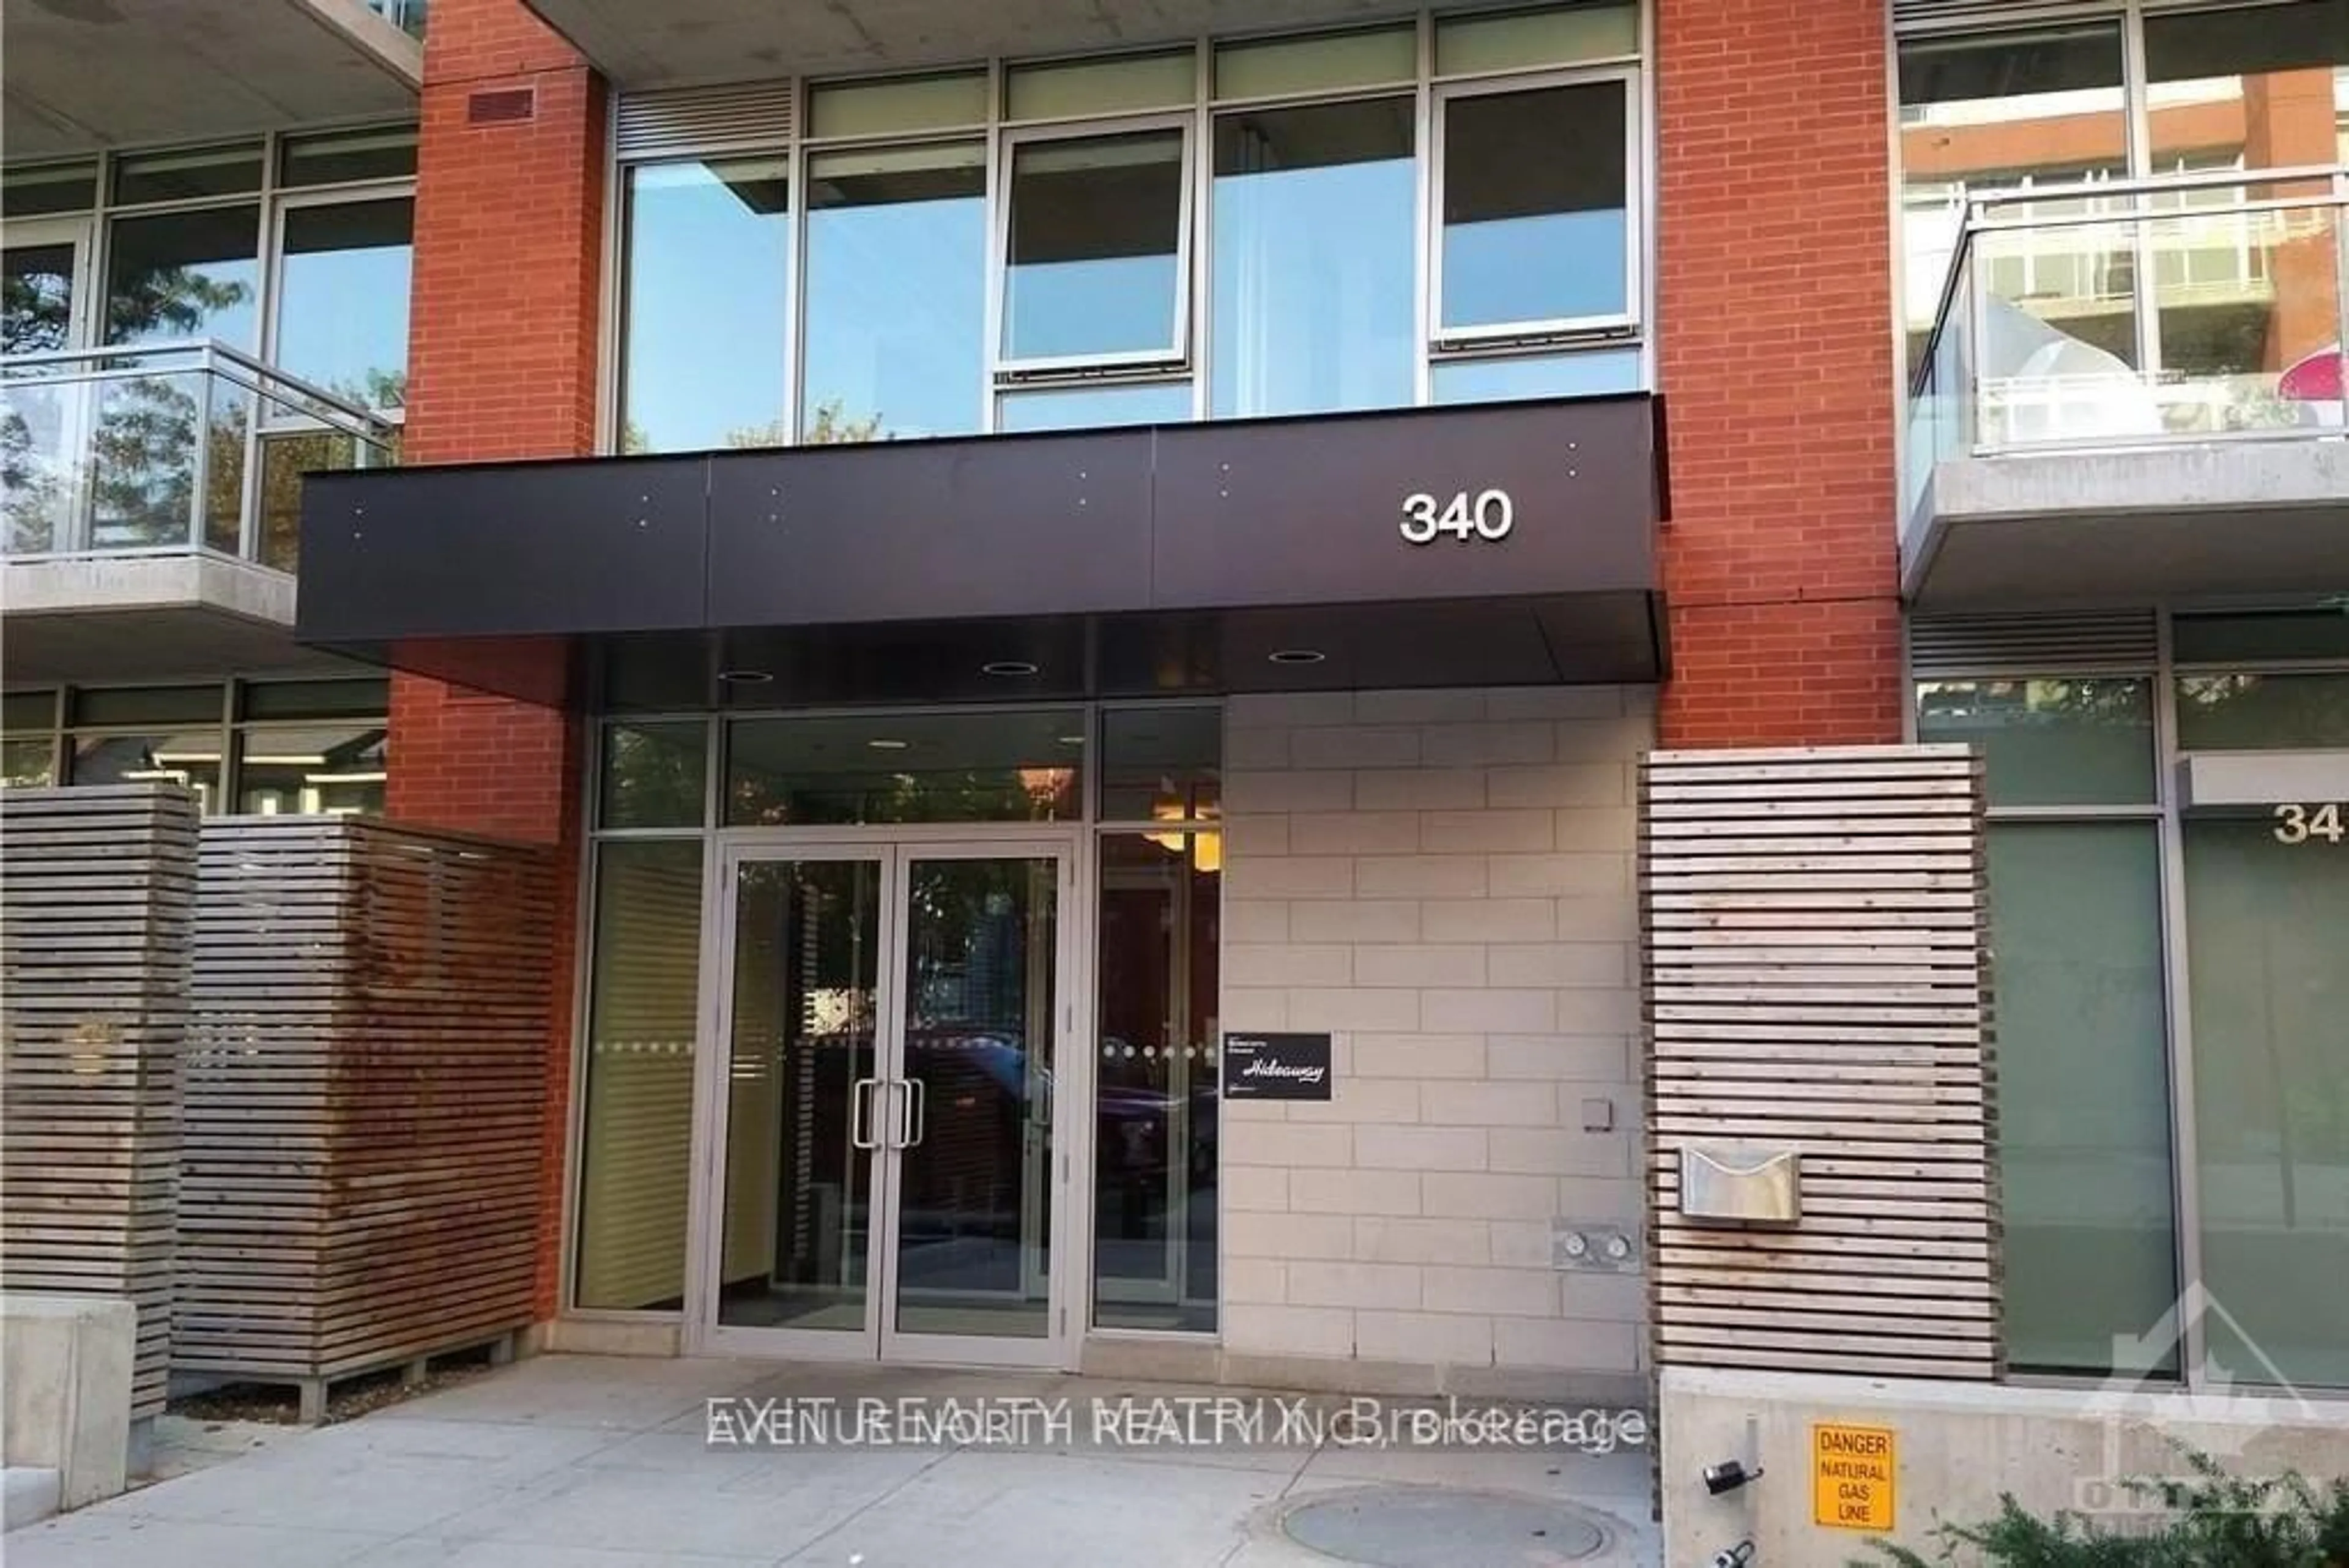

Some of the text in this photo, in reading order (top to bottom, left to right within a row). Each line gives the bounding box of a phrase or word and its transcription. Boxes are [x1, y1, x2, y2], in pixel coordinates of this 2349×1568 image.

[1399, 489, 1513, 544] 340
[1242, 1058, 1324, 1083] Hideaway
[1820, 1432, 1886, 1454] DANGER
[1820, 1461, 1886, 1481] NATURAL
[1839, 1483, 1870, 1501] GAS
[1839, 1505, 1870, 1522] LINE
